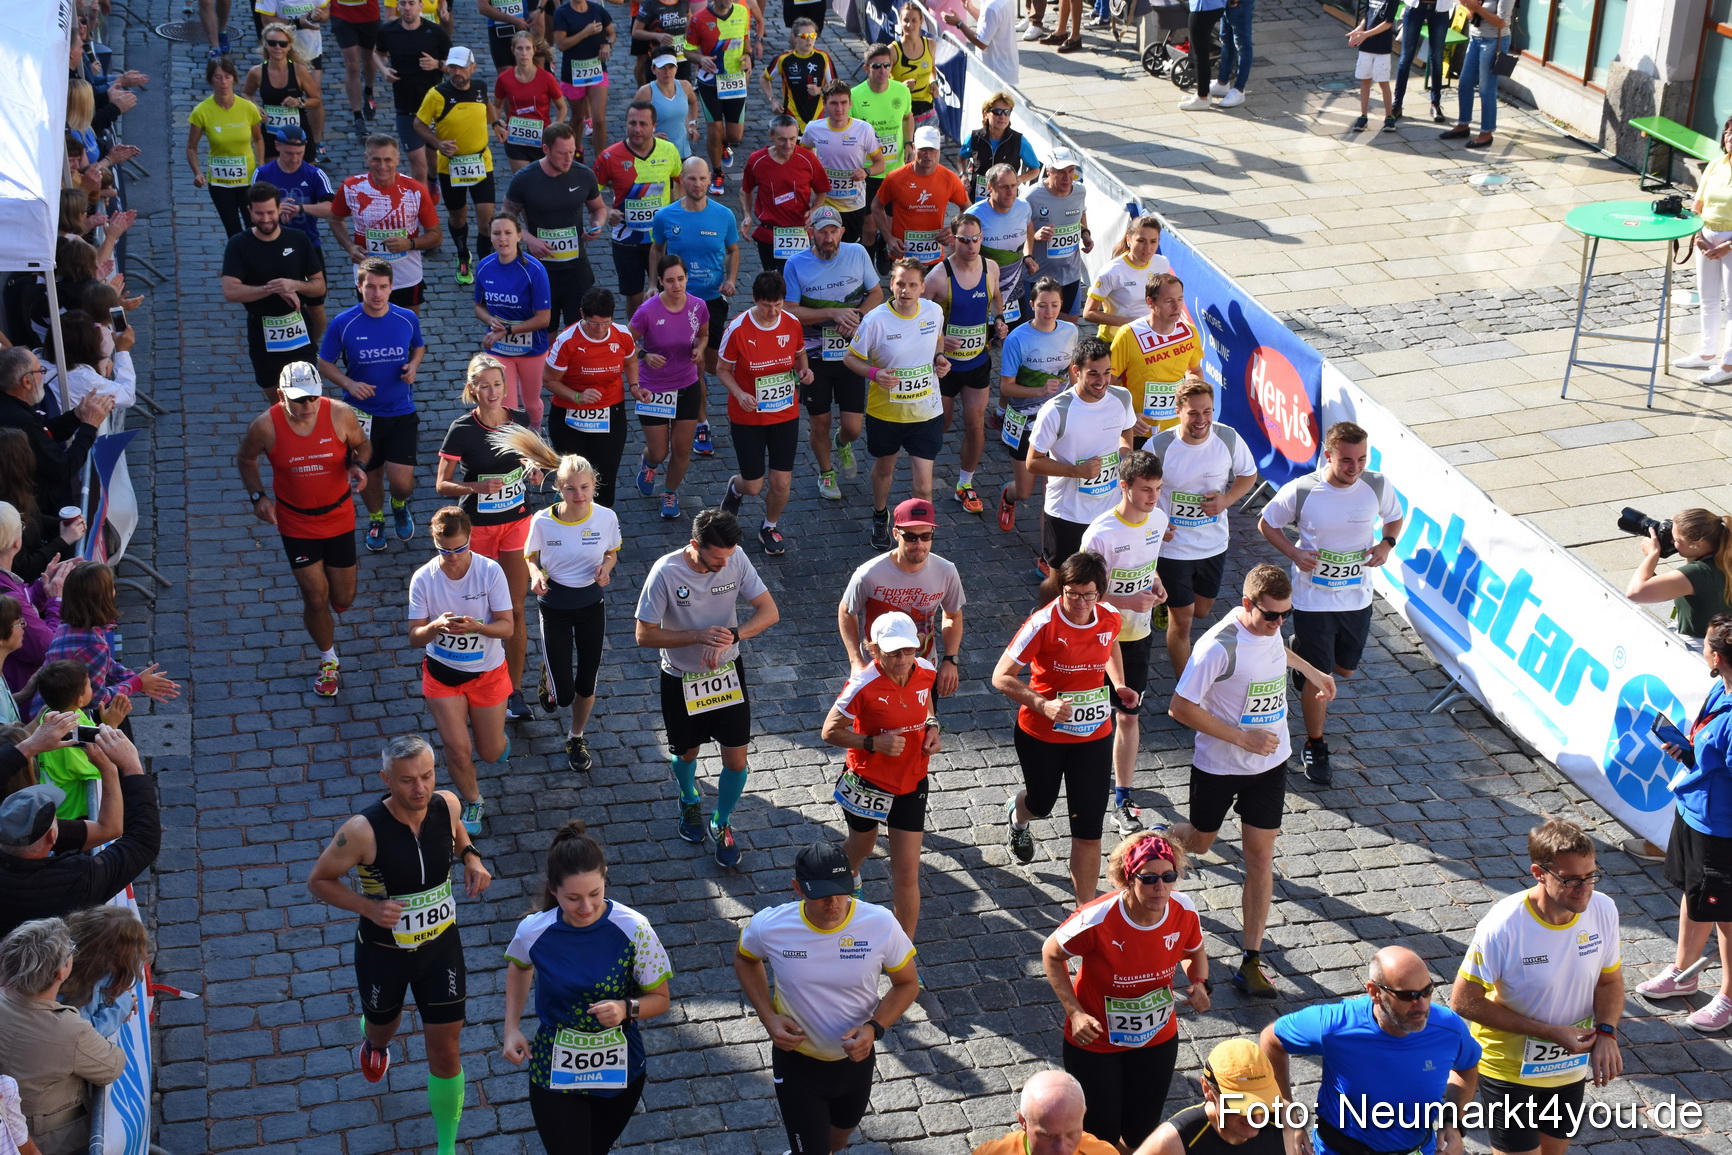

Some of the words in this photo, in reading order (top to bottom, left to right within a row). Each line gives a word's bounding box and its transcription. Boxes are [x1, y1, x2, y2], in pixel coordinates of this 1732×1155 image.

[660, 12, 679, 21] HECK
[576, 67, 600, 78] 2770
[720, 80, 744, 90] 2693
[268, 116, 296, 126] 2710
[512, 127, 539, 139] 2580
[882, 145, 894, 154] 07
[452, 156, 480, 164] BOCK
[214, 168, 243, 177] 1143
[453, 165, 482, 176] 1341
[369, 230, 404, 238] BOCK
[541, 228, 575, 238] BOCK
[776, 228, 807, 236] BOCK
[371, 241, 386, 252] 21
[546, 240, 574, 251] 401
[778, 238, 806, 248] 2577
[909, 241, 939, 252] 2640
[1052, 234, 1079, 248] 2090
[1058, 247, 1074, 255] JOSEF
[485, 291, 519, 304] SYSCAD
[267, 314, 300, 326] BOCK
[269, 325, 302, 340] 2784
[951, 326, 982, 336] BOCK
[500, 334, 526, 345] 141
[960, 337, 982, 348] 203
[359, 347, 404, 359] SYSCAD
[498, 344, 523, 352] VERENA
[1145, 352, 1171, 366] MAX
[1174, 341, 1195, 357] BÖGL
[1209, 335, 1230, 362] ONLINE
[895, 367, 929, 378] BOCK
[1206, 361, 1228, 390] MOBILE
[760, 375, 791, 386] BOCK
[898, 377, 930, 392] 1345
[762, 384, 791, 400] 2259
[896, 391, 928, 399] MANFRED
[765, 400, 788, 408] ANGELA
[1150, 396, 1176, 408] 237
[1250, 352, 1312, 448] Hervis
[638, 404, 672, 414] CHRISTINE
[572, 410, 605, 420] 2092
[574, 421, 600, 429] MARGIT
[1090, 485, 1111, 494] JONAS
[492, 500, 514, 509] JULIA
[1176, 505, 1205, 518] 222
[1174, 518, 1214, 526] CHRISTIAN
[1322, 550, 1364, 562] BOCK
[1116, 564, 1153, 580] BOCK
[1319, 564, 1360, 578] 2230
[712, 583, 736, 593] BOCK
[1114, 575, 1149, 593] 2815
[873, 585, 922, 597] FINISHER
[883, 592, 918, 604] RELAY
[918, 592, 944, 604] TEAM
[438, 633, 479, 650] 2797
[690, 675, 732, 697] 1101
[1253, 677, 1286, 693] BOCK
[696, 694, 733, 708] FLORIAN
[1250, 697, 1284, 713] 2228
[1066, 705, 1105, 722] 085
[1251, 713, 1281, 723] MATTEO
[1063, 723, 1100, 733] BIRGITTA
[842, 785, 885, 812] 2136
[842, 799, 875, 817] RENATE
[402, 886, 447, 908] BOCK
[401, 903, 450, 931] 1180
[414, 928, 439, 942] RENE
[1577, 934, 1588, 944] 20
[840, 937, 853, 947] 20
[1523, 955, 1548, 963] BOCK
[1113, 973, 1153, 981] ENGELHARDT
[1112, 992, 1163, 1010] BOCK
[1115, 1006, 1167, 1031] 2517
[561, 1031, 617, 1047] BOCK
[1533, 1044, 1571, 1061] 254
[561, 1048, 618, 1069] 2605
[1532, 1059, 1580, 1073] ANDREAS
[575, 1072, 603, 1082] NINA
